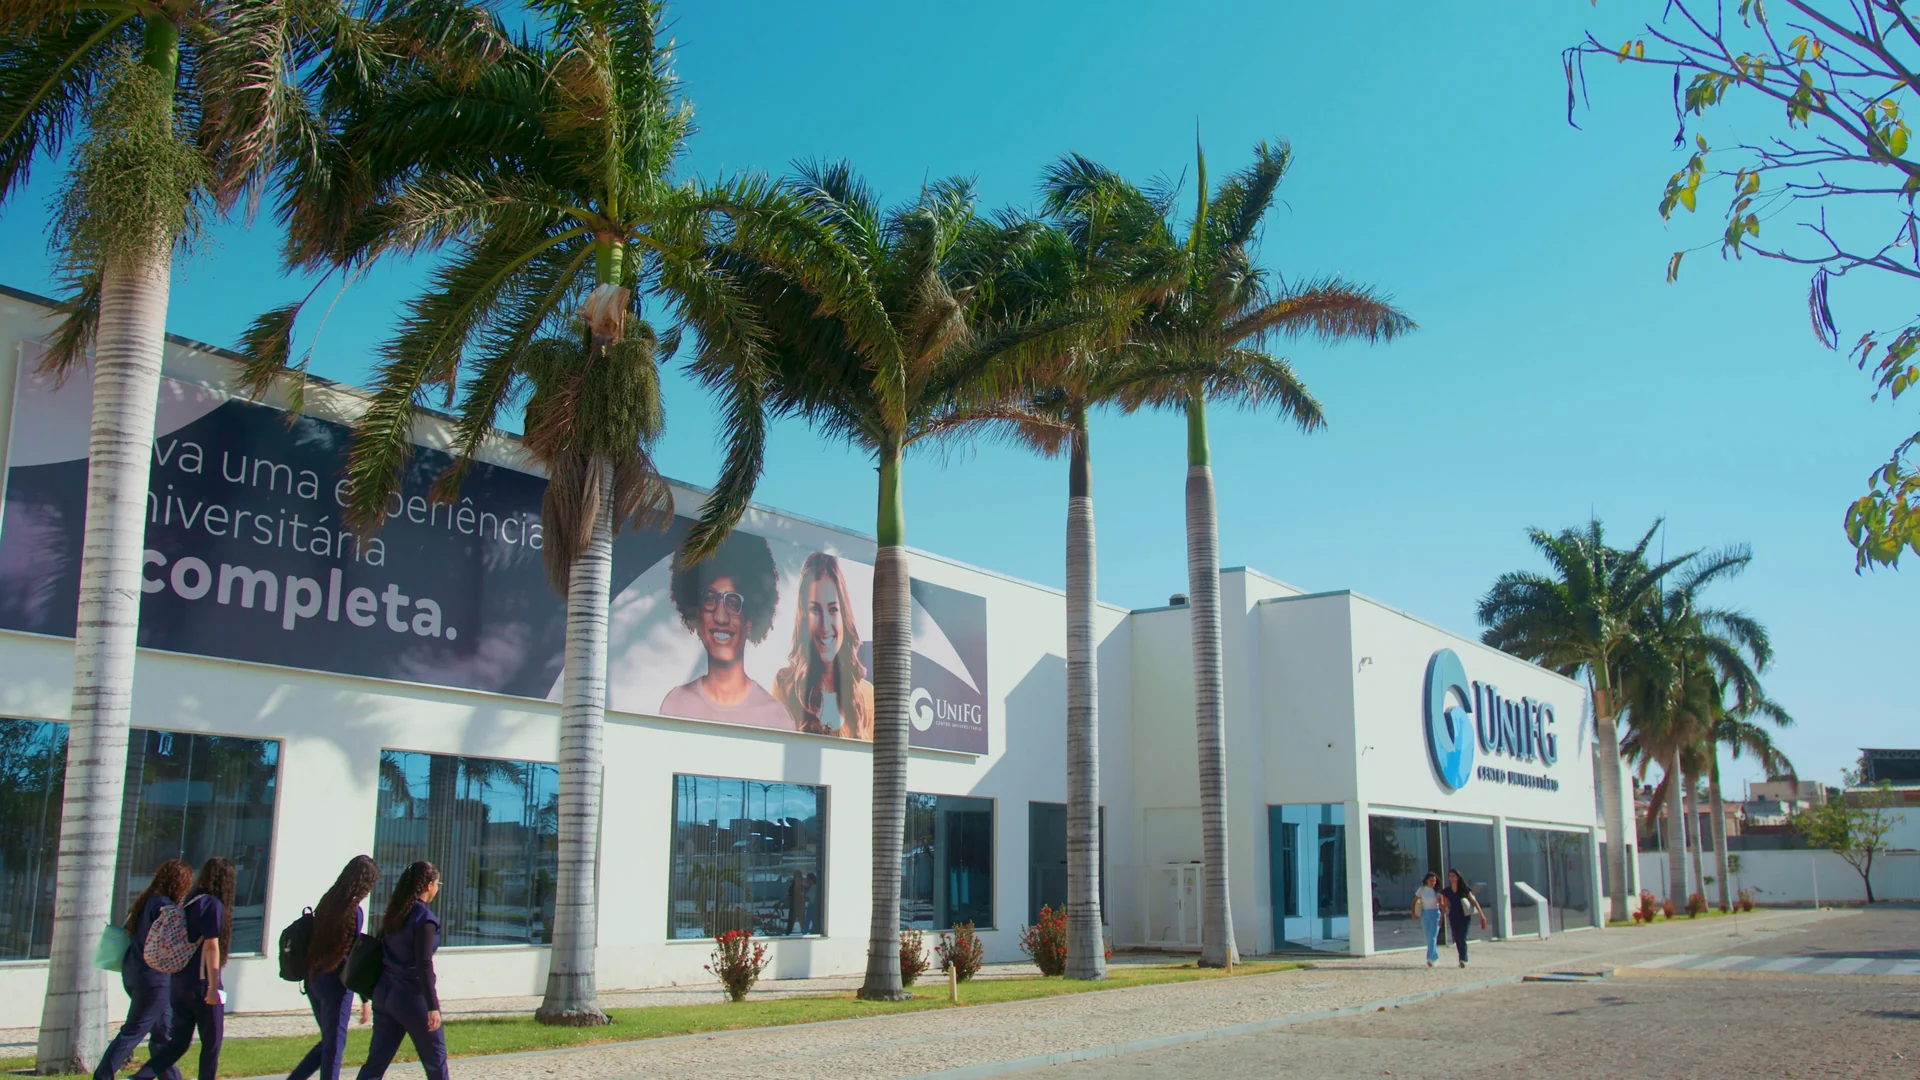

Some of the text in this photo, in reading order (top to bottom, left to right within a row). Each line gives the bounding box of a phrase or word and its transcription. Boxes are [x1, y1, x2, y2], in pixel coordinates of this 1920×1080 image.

[147, 484, 385, 567] niversitária
[153, 439, 543, 549] va uma eperiência
[141, 549, 458, 641] completa.
